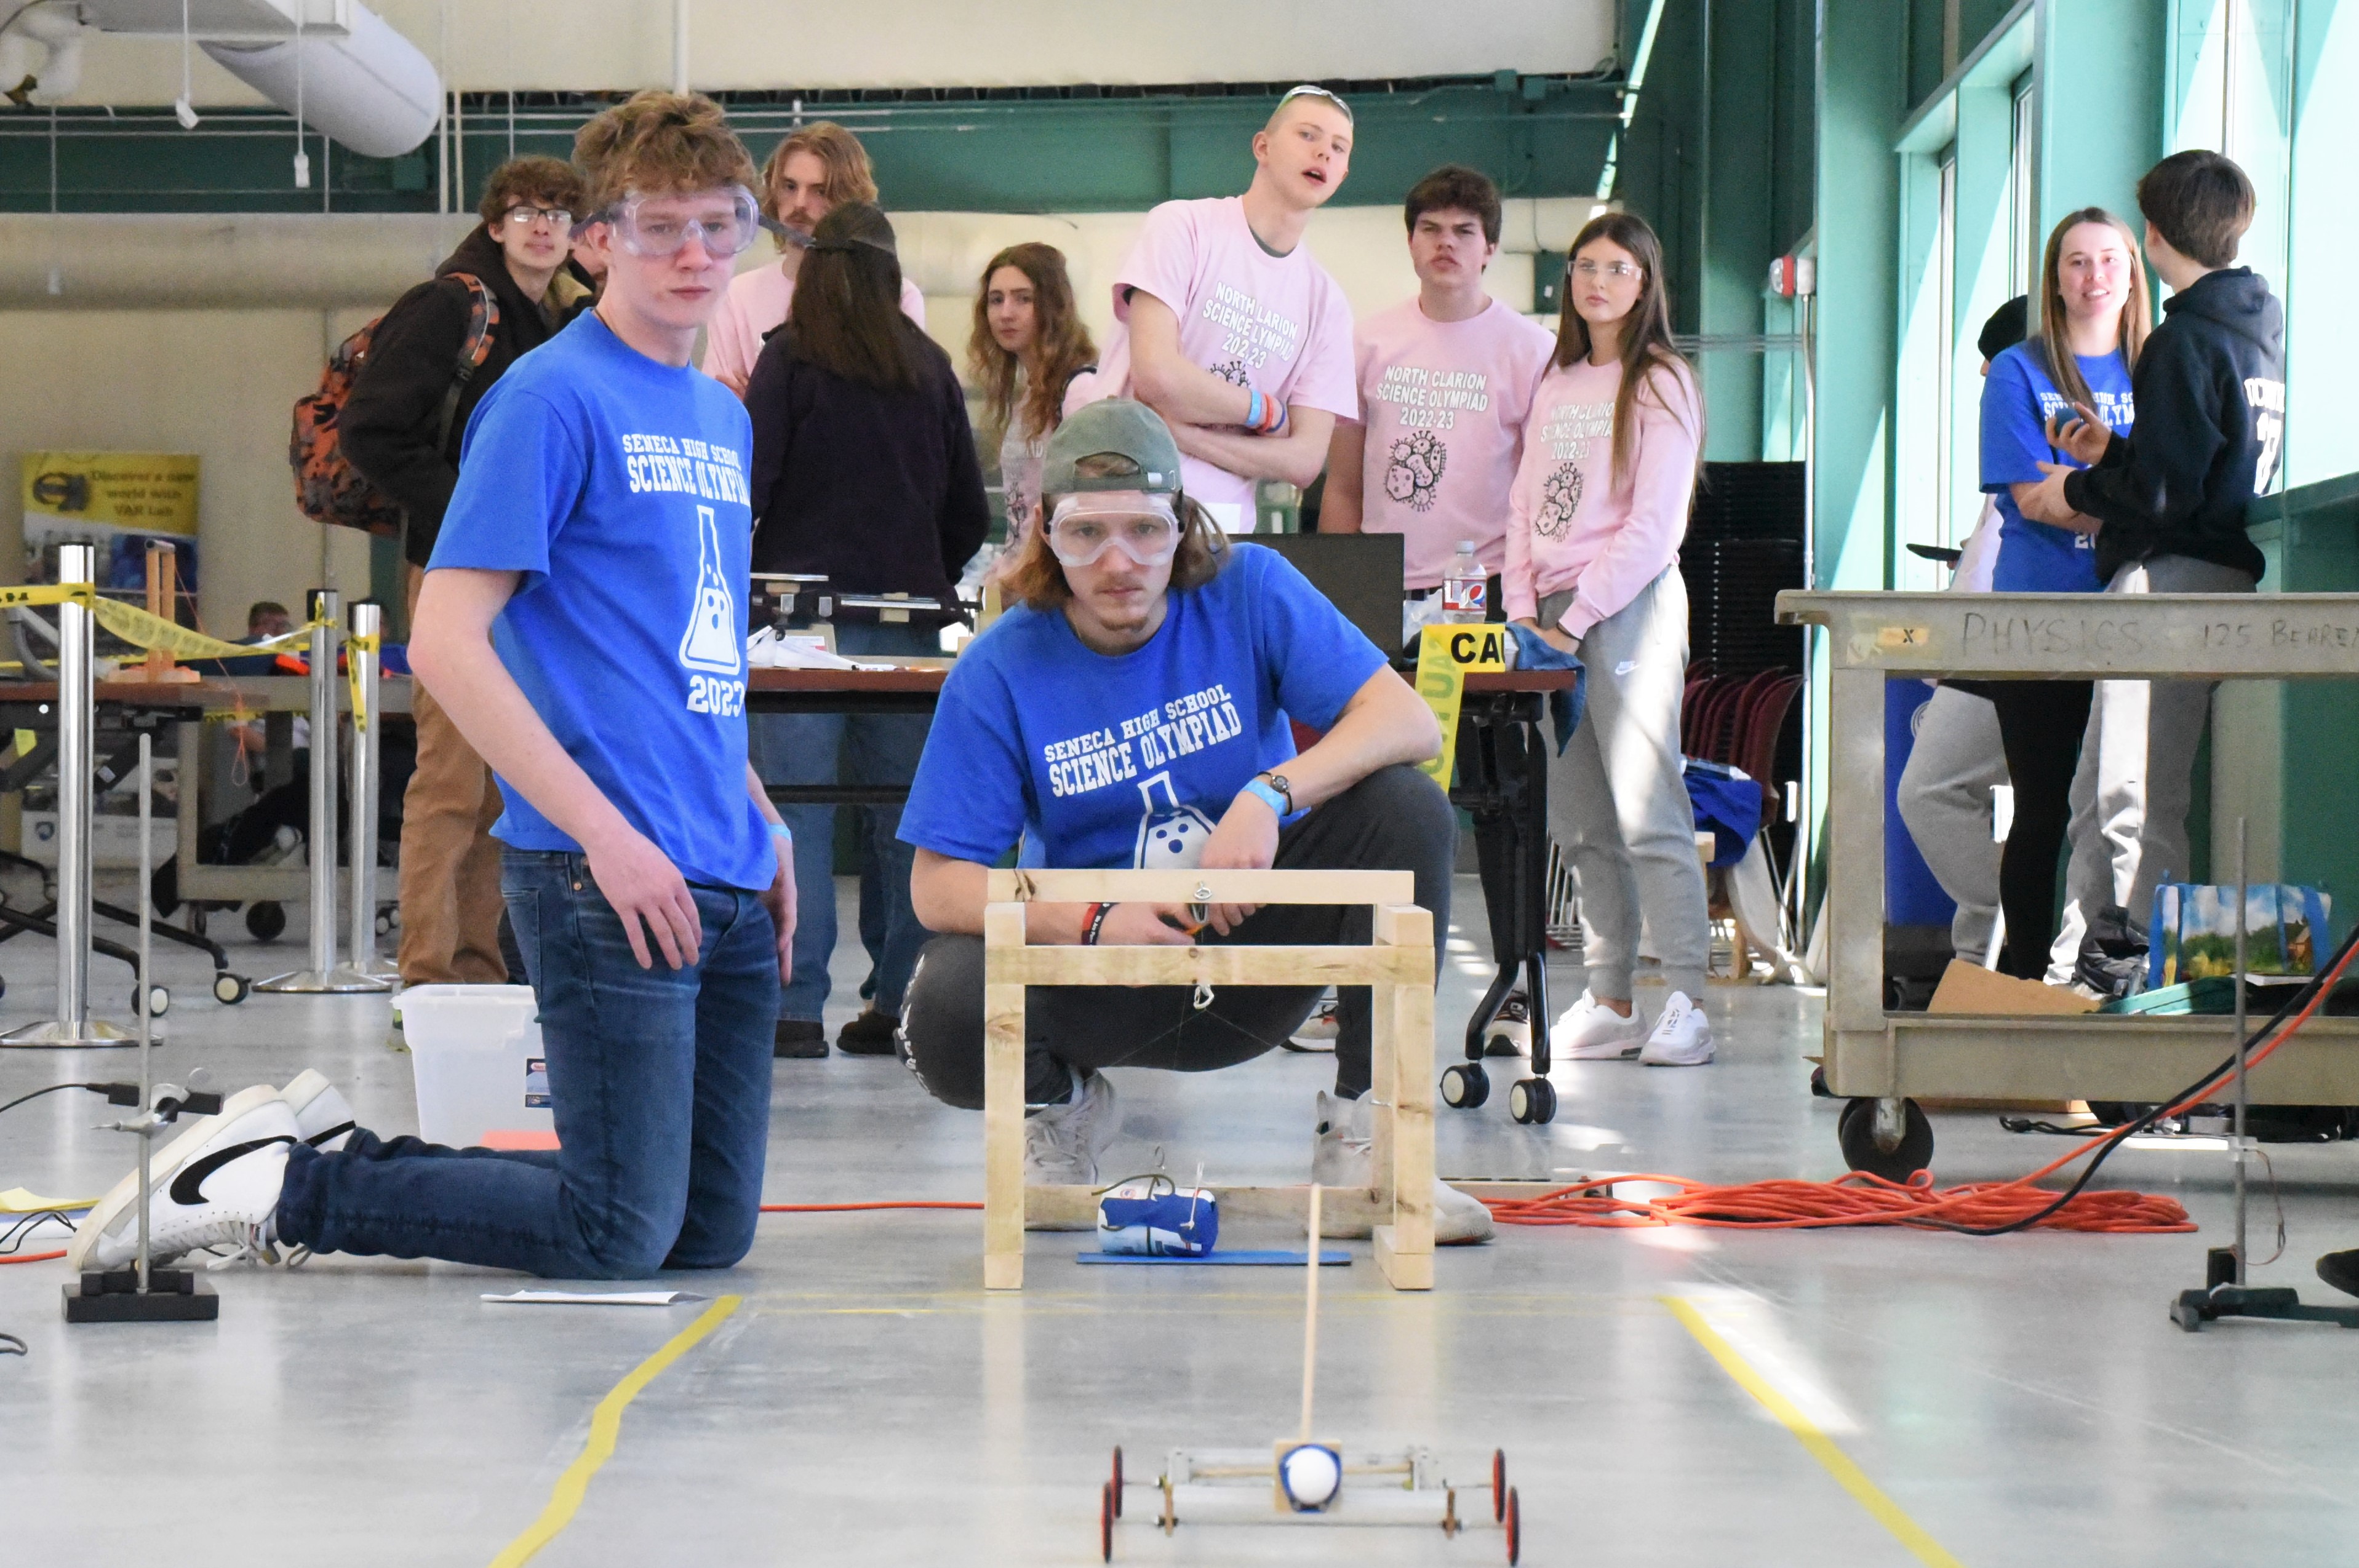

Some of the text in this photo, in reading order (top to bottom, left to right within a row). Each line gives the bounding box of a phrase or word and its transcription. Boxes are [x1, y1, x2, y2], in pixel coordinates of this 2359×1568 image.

[1202, 299, 1295, 362] SCIENCE LYMPIAD
[1215, 281, 1298, 340] NORTH LARION
[1221, 332, 1267, 369] 20223
[1376, 383, 1488, 412] SCIENCE OLYMPIAD
[1384, 365, 1487, 391] NORTH CLARION
[1573, 420, 1613, 439] OLYMPIA
[622, 434, 742, 472] SENECA HIGH SCHOOL
[627, 455, 751, 507] SCIENCE OLYMPIA
[1450, 632, 1505, 664] CA
[1962, 612, 2142, 656] PHYSICS
[2204, 623, 2252, 648] 125
[1044, 684, 1231, 762] SENECA HIGH SCHOOL
[1049, 701, 1242, 797] SCIENCE OLYMPIAD
